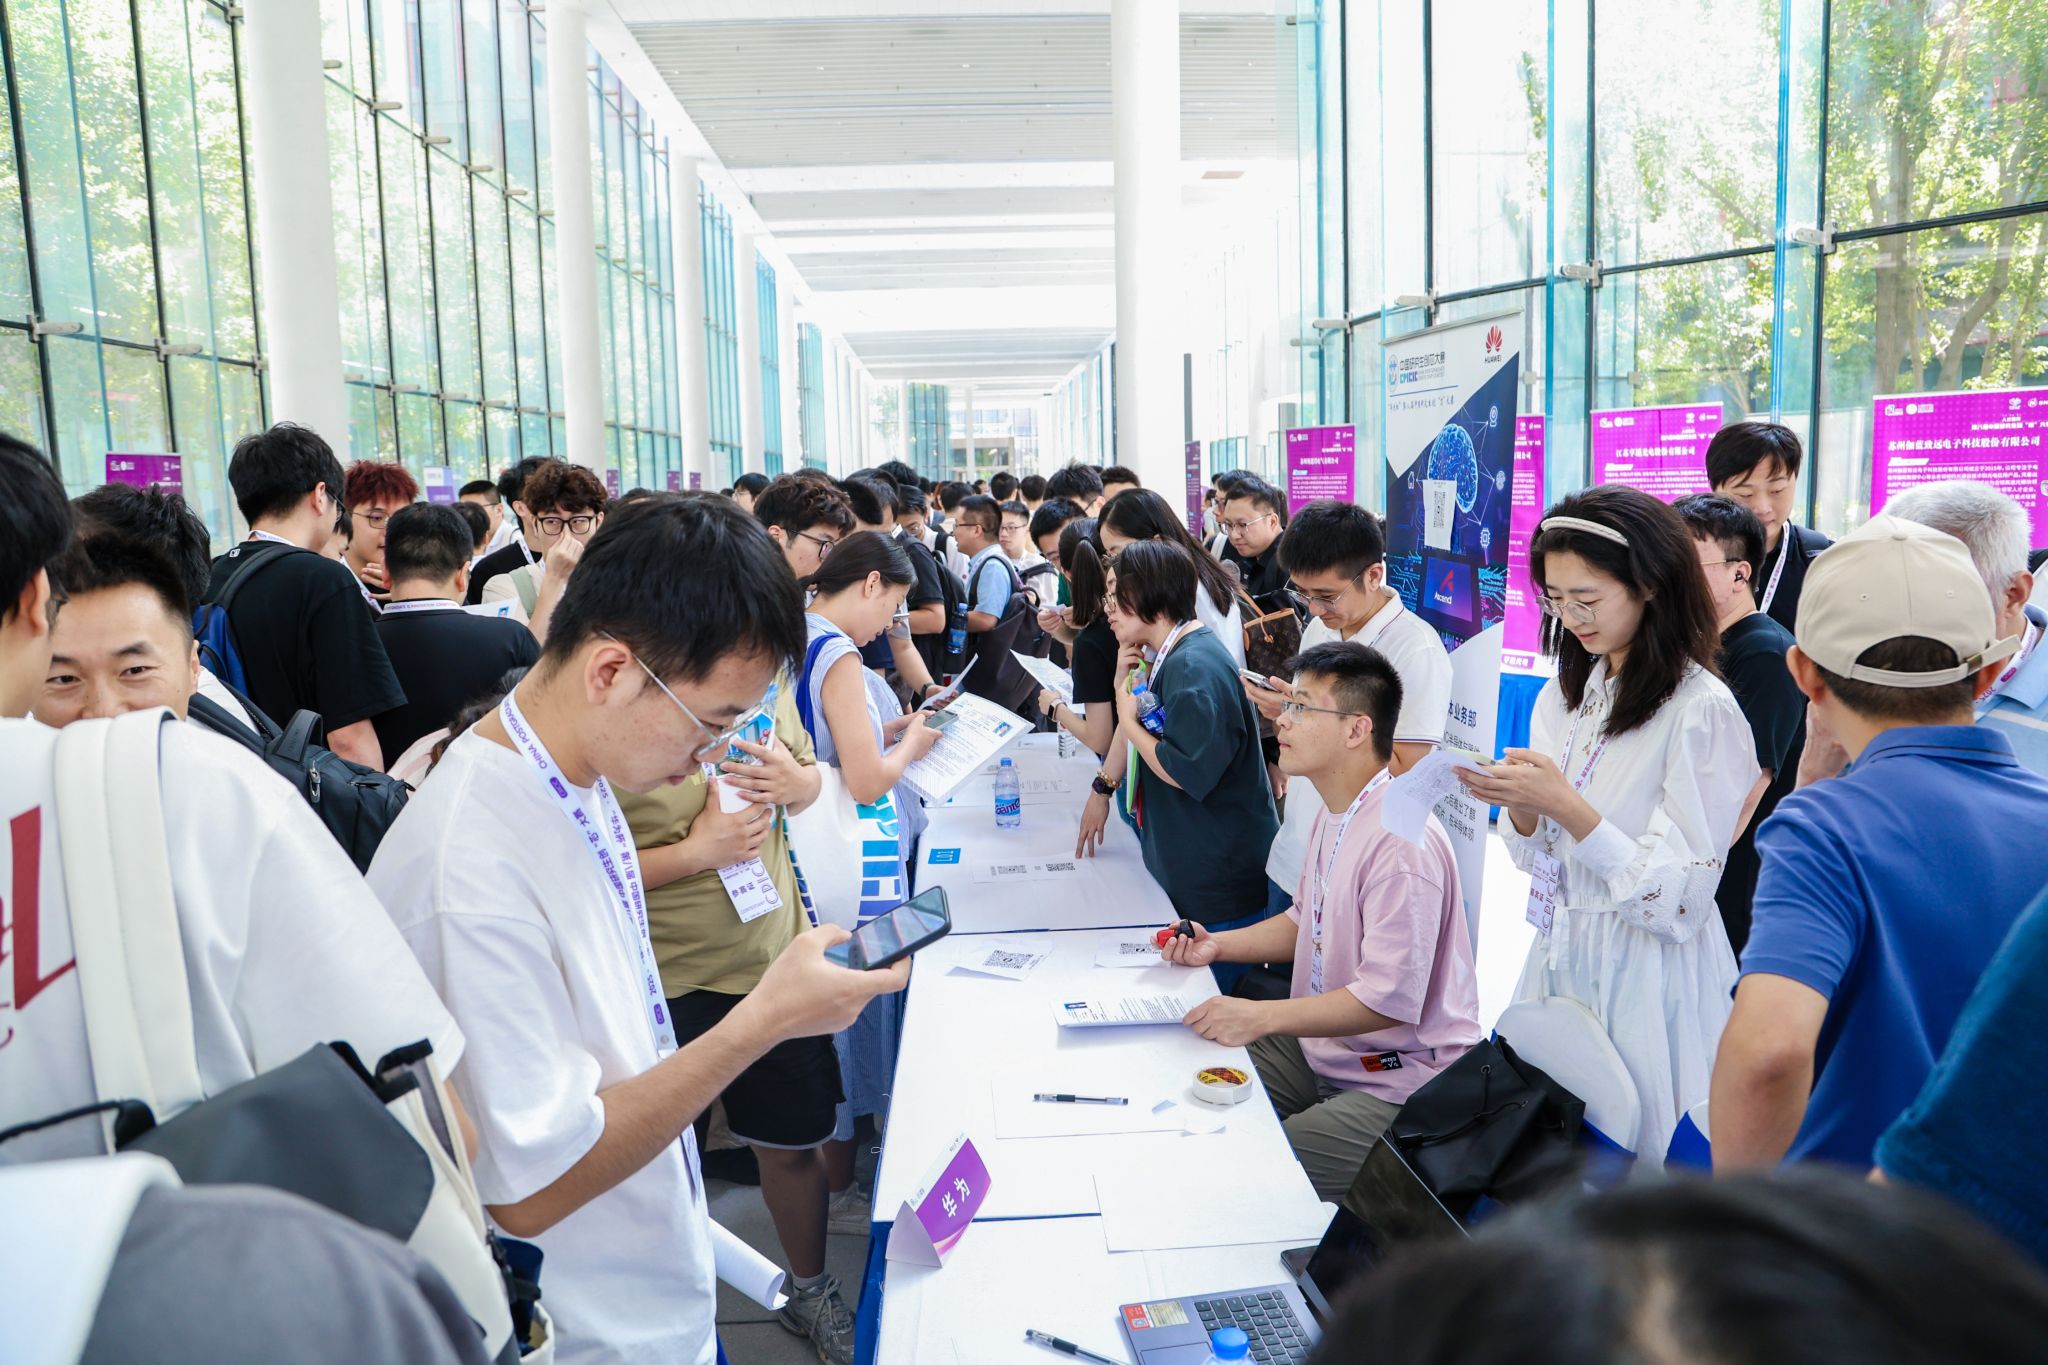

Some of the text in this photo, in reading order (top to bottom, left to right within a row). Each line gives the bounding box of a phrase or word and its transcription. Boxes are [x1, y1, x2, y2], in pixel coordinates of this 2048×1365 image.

[1433, 591, 1453, 605] Ascend
[528, 744, 548, 769] CHINA
[941, 1177, 971, 1218] 华为
